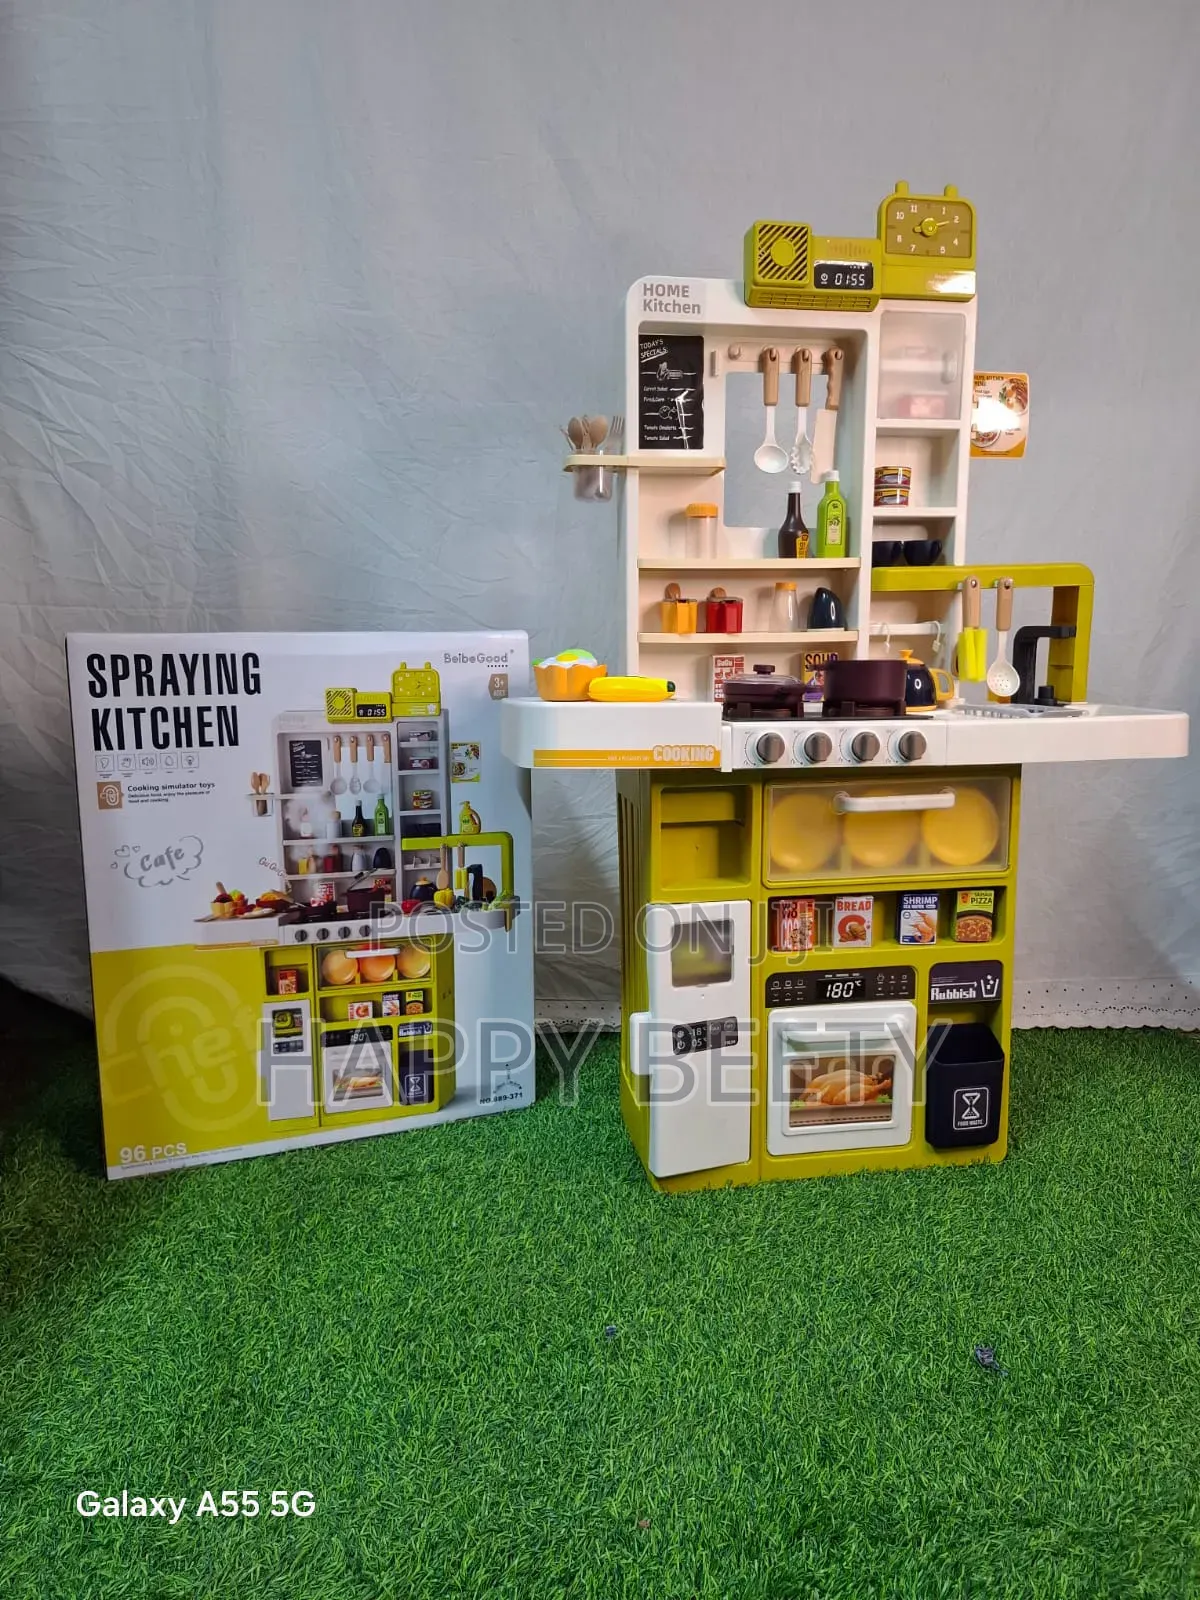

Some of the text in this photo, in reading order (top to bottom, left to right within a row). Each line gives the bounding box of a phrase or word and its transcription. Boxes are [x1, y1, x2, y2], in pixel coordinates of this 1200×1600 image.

[910, 204, 918, 213] 11
[942, 206, 946, 215] 1
[896, 211, 904, 220] 10
[953, 215, 960, 224] 2
[953, 237, 959, 246] 4
[910, 244, 916, 252] 7
[643, 283, 690, 298] HOME
[643, 298, 701, 315] Kitchen
[86, 652, 262, 699] SPRAYING
[493, 677, 505, 688] 3+
[91, 705, 239, 752] KITCHEN
[653, 745, 715, 762] COOKING
[127, 784, 160, 792] Cooking
[836, 900, 872, 912] BREAD
[903, 896, 938, 905] SHRIMP
[930, 987, 977, 1001] Rubbish
[120, 1144, 147, 1164] 96
[152, 1142, 188, 1159] PCS
